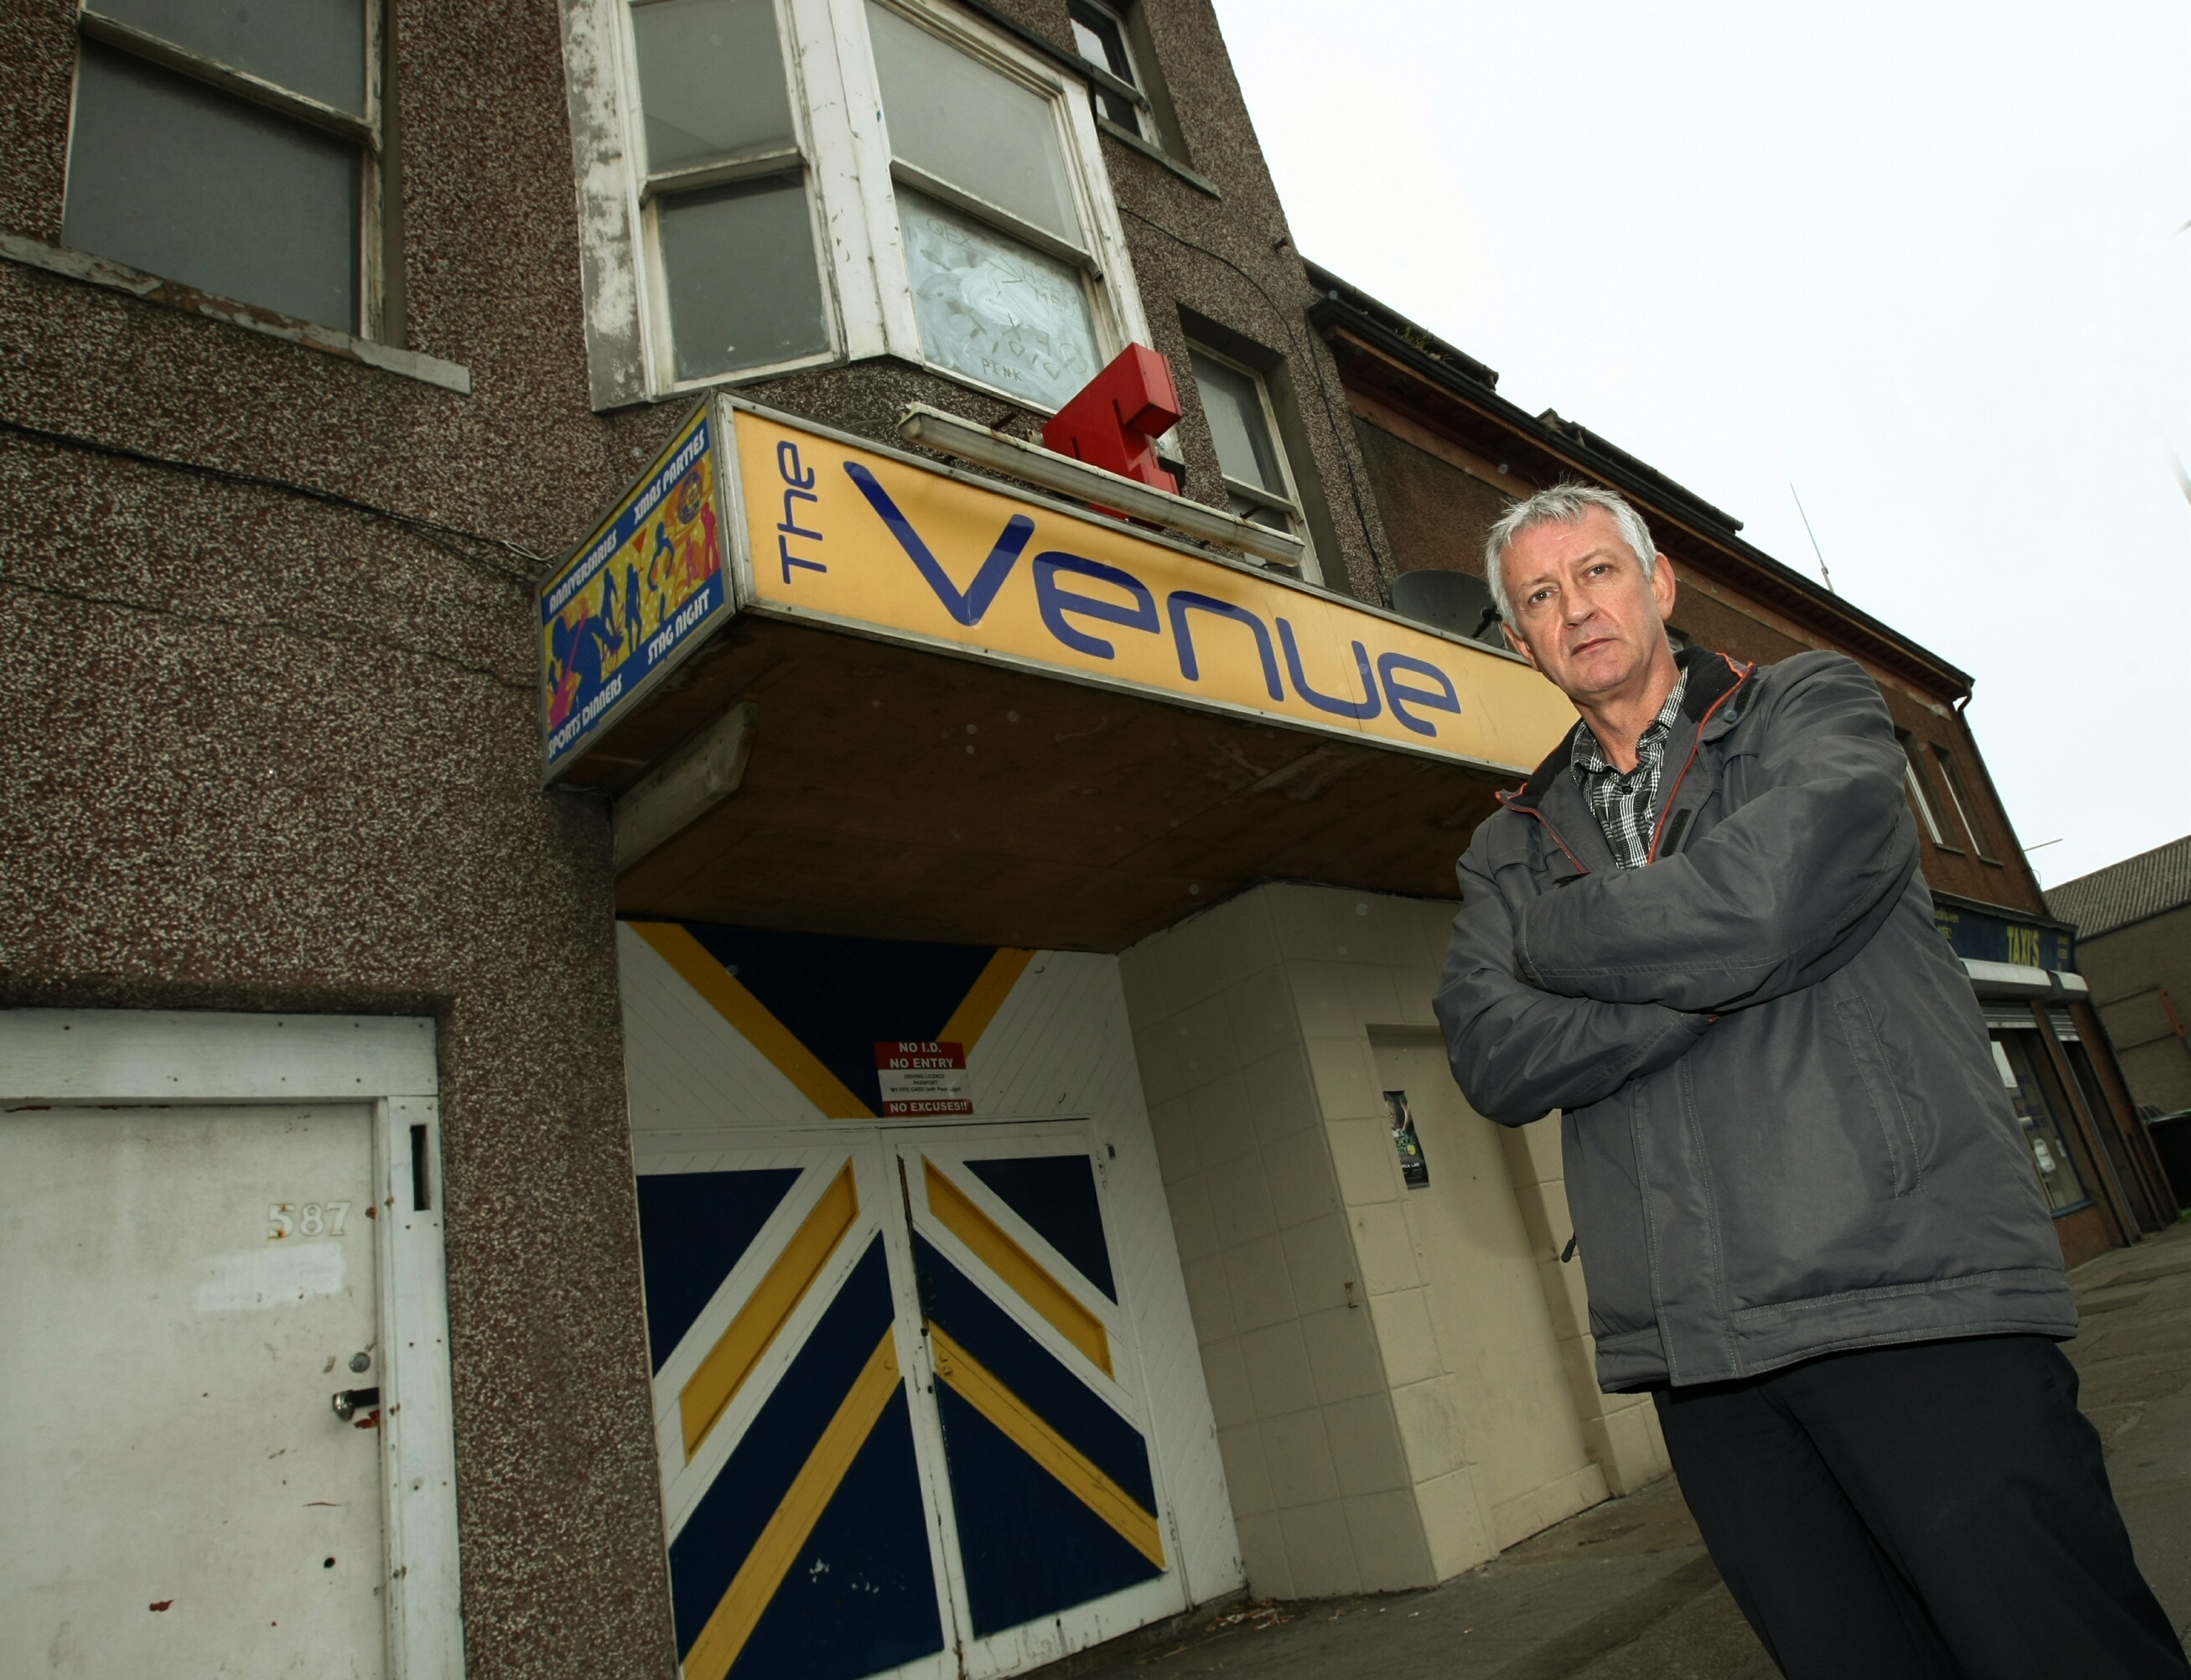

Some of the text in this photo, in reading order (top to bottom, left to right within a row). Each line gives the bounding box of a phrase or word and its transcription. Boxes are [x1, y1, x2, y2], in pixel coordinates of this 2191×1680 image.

[980, 357, 1023, 382] PINK
[633, 428, 705, 525] XMAS PARTIES
[549, 529, 618, 615] ANNIVERSARIES
[776, 440, 1461, 738] The Venue
[648, 588, 711, 665] STAG NIGHT
[547, 673, 623, 759] SPORTS DINNERS
[889, 1058, 954, 1068] NO ENTRY
[899, 1042, 942, 1053] NO I.D.
[890, 1101, 968, 1113] NO EXCUSES!!
[268, 1201, 351, 1240] 587
